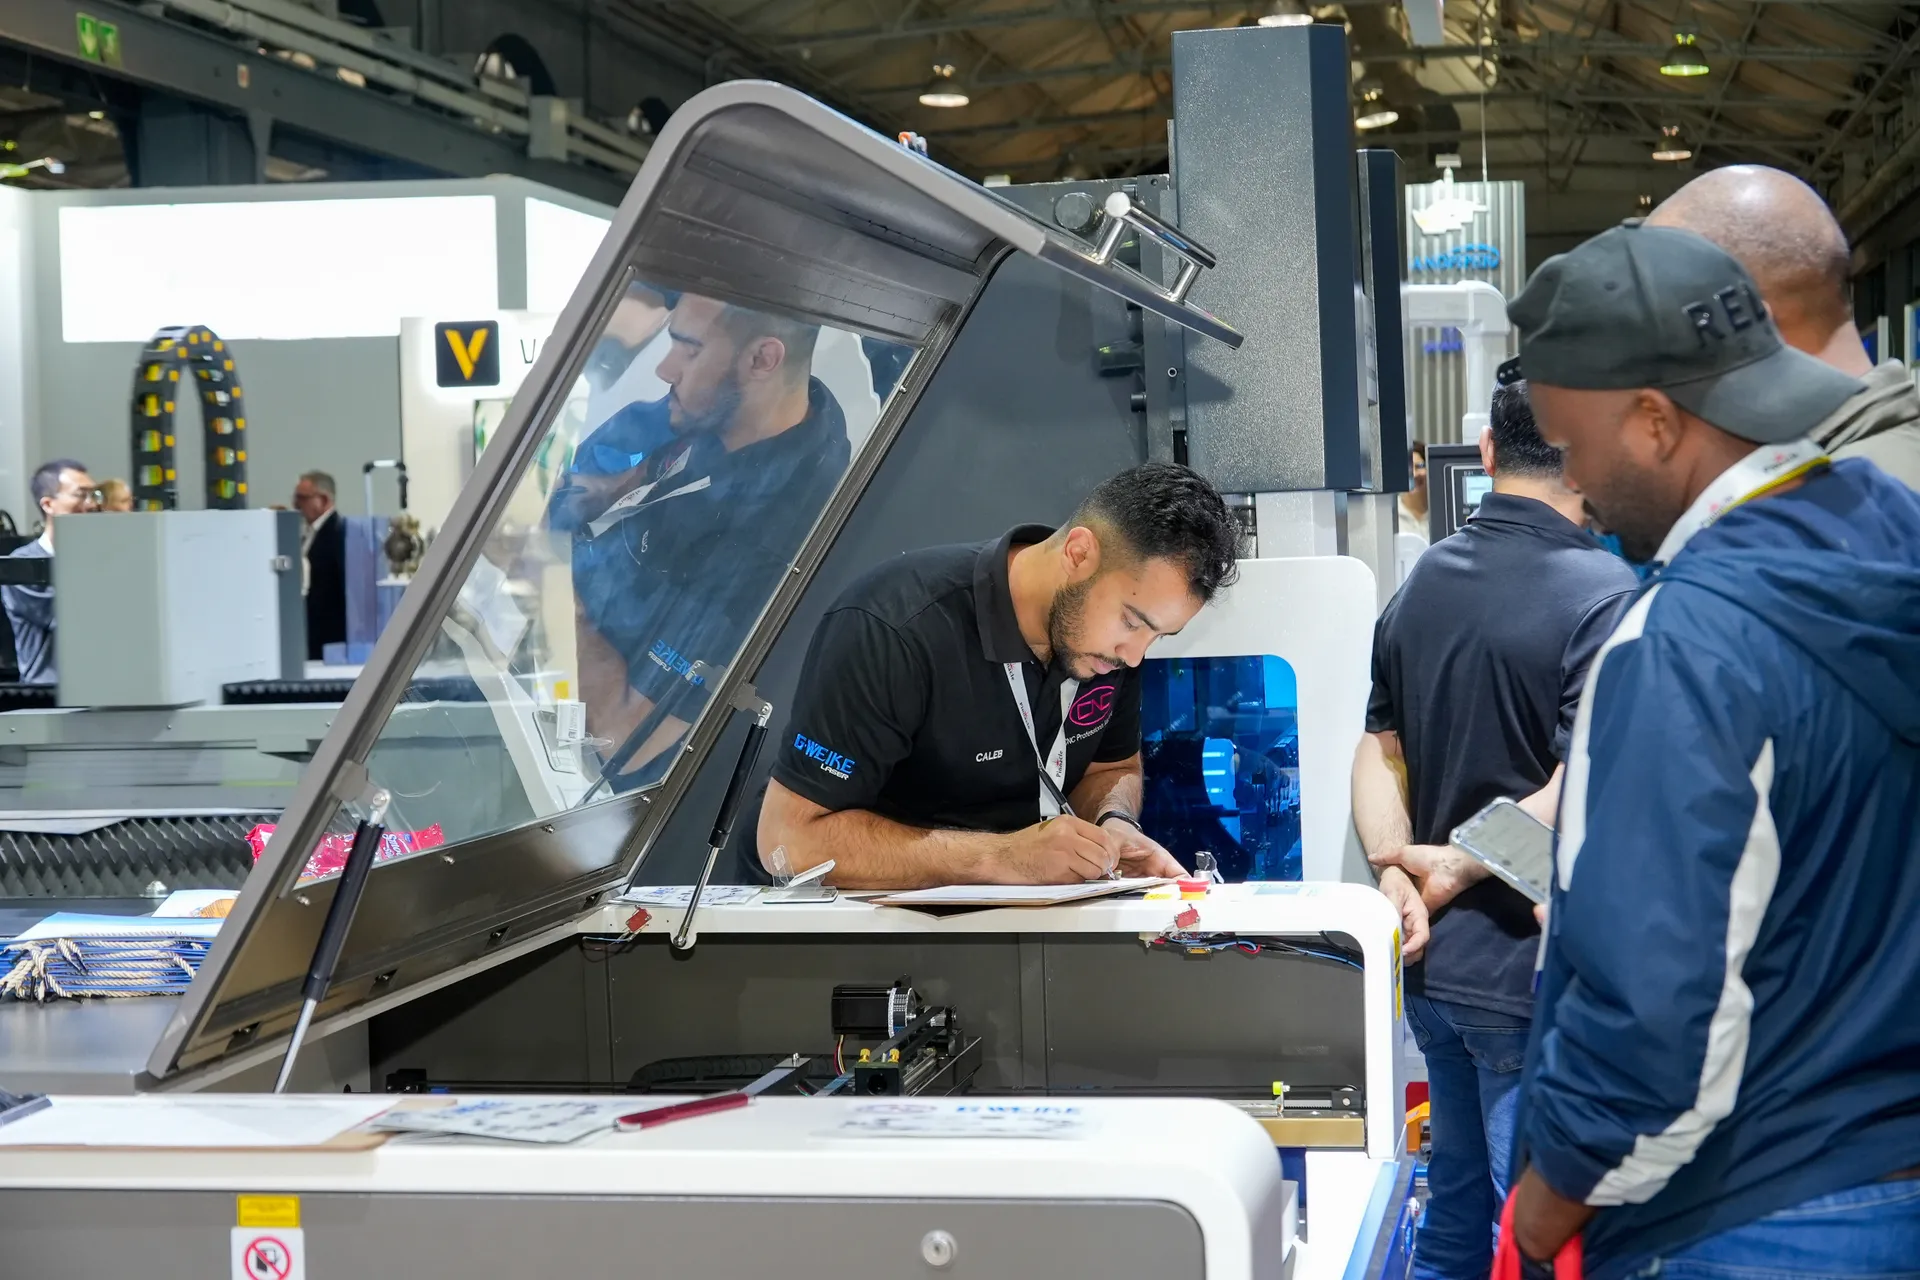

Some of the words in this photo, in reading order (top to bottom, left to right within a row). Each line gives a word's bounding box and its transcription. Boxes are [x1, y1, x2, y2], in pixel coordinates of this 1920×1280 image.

[975, 749, 1003, 762] CALEB
[1056, 750, 1064, 778] Pinnacle
[820, 763, 849, 781] LASER
